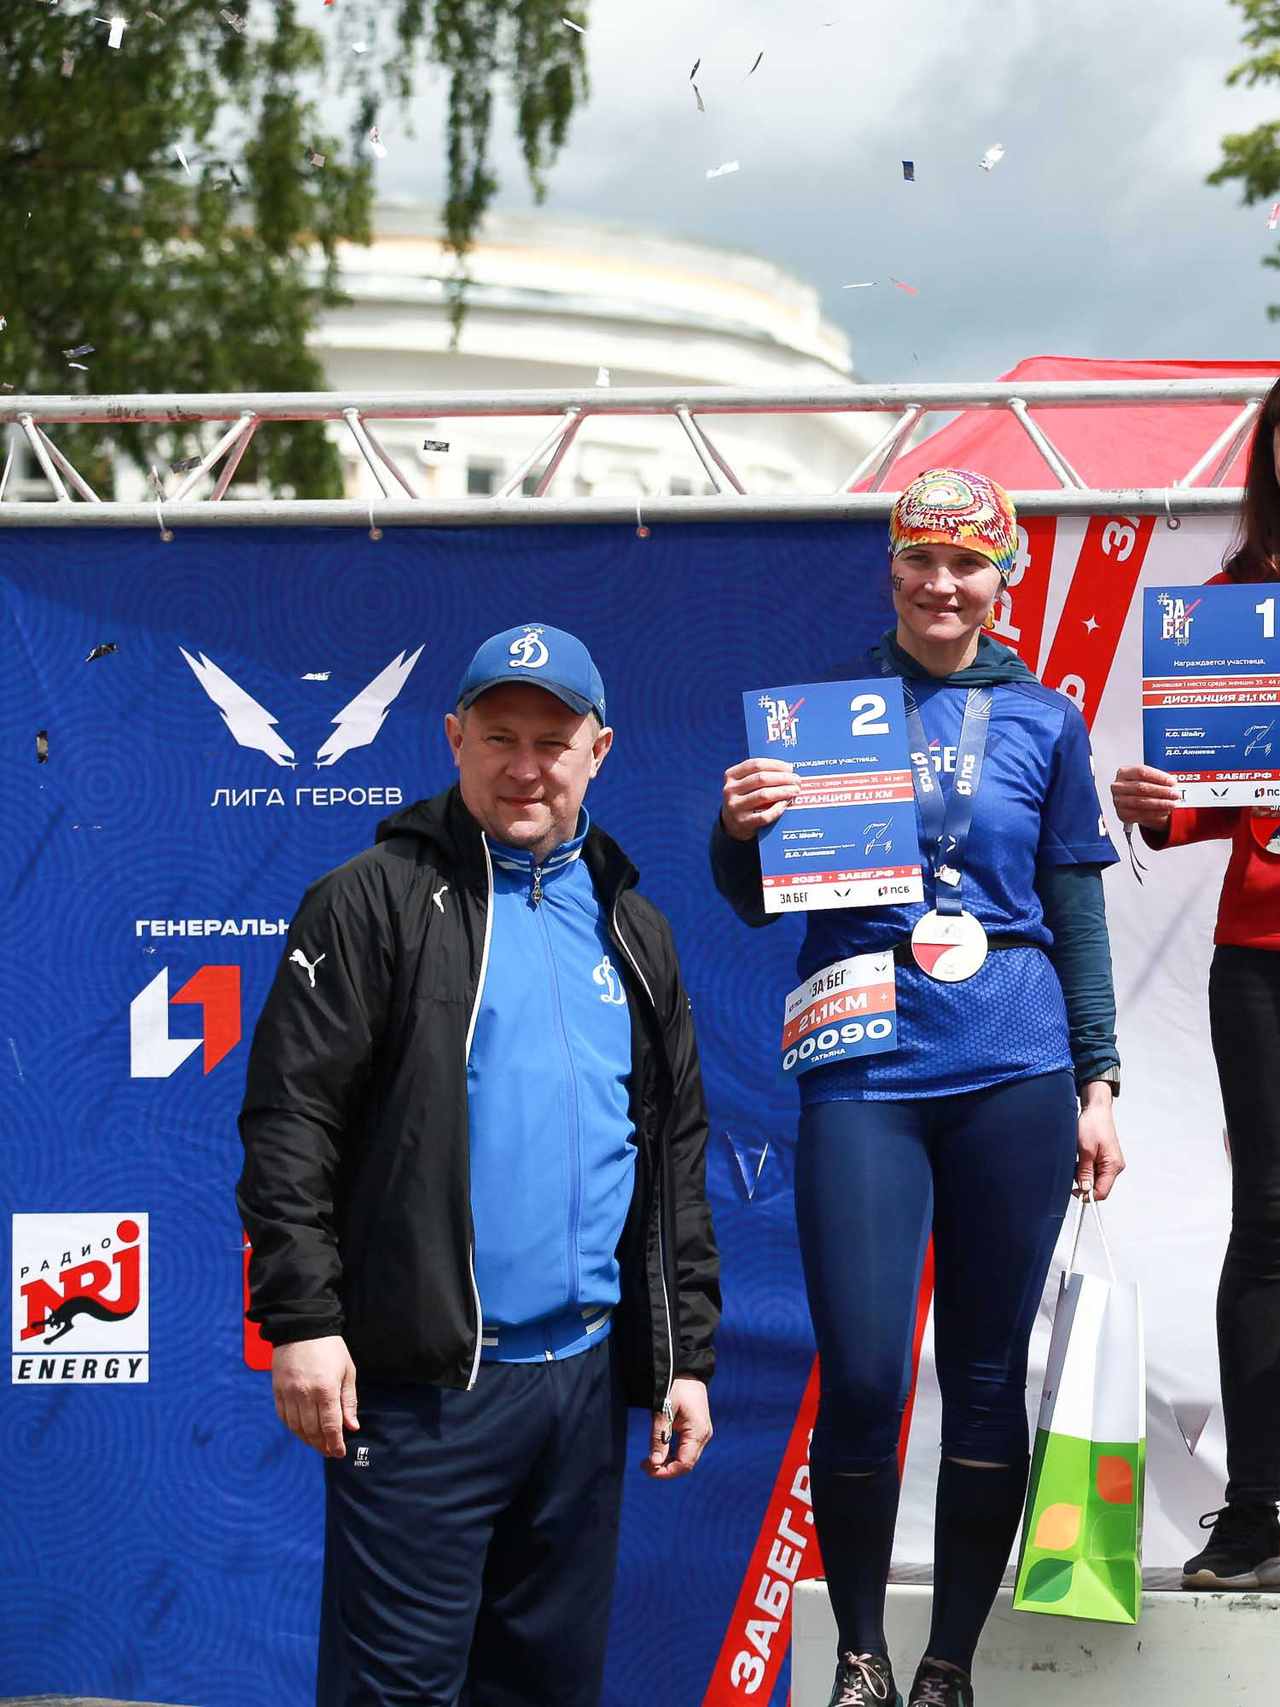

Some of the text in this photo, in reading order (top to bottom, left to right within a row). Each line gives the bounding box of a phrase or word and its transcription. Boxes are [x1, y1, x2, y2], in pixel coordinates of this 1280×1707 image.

[1255, 598, 1275, 638] 1
[1173, 660, 1226, 668] Награждается
[1162, 692, 1278, 704] ДИСТАНЦИЯ 21,1 КМ
[850, 693, 890, 736] 2
[1215, 772, 1273, 780] ЗАБЕГ.РФ
[210, 787, 404, 807] ЛИГА ГЕРОЕВ
[874, 789, 894, 799] КМ
[890, 885, 910, 895] ПСБ
[782, 1018, 893, 1071] 00090
[810, 1047, 846, 1063] ТАТЬЯНА
[20, 1237, 112, 1279] РАДИО
[17, 1358, 143, 1380] ENERGY
